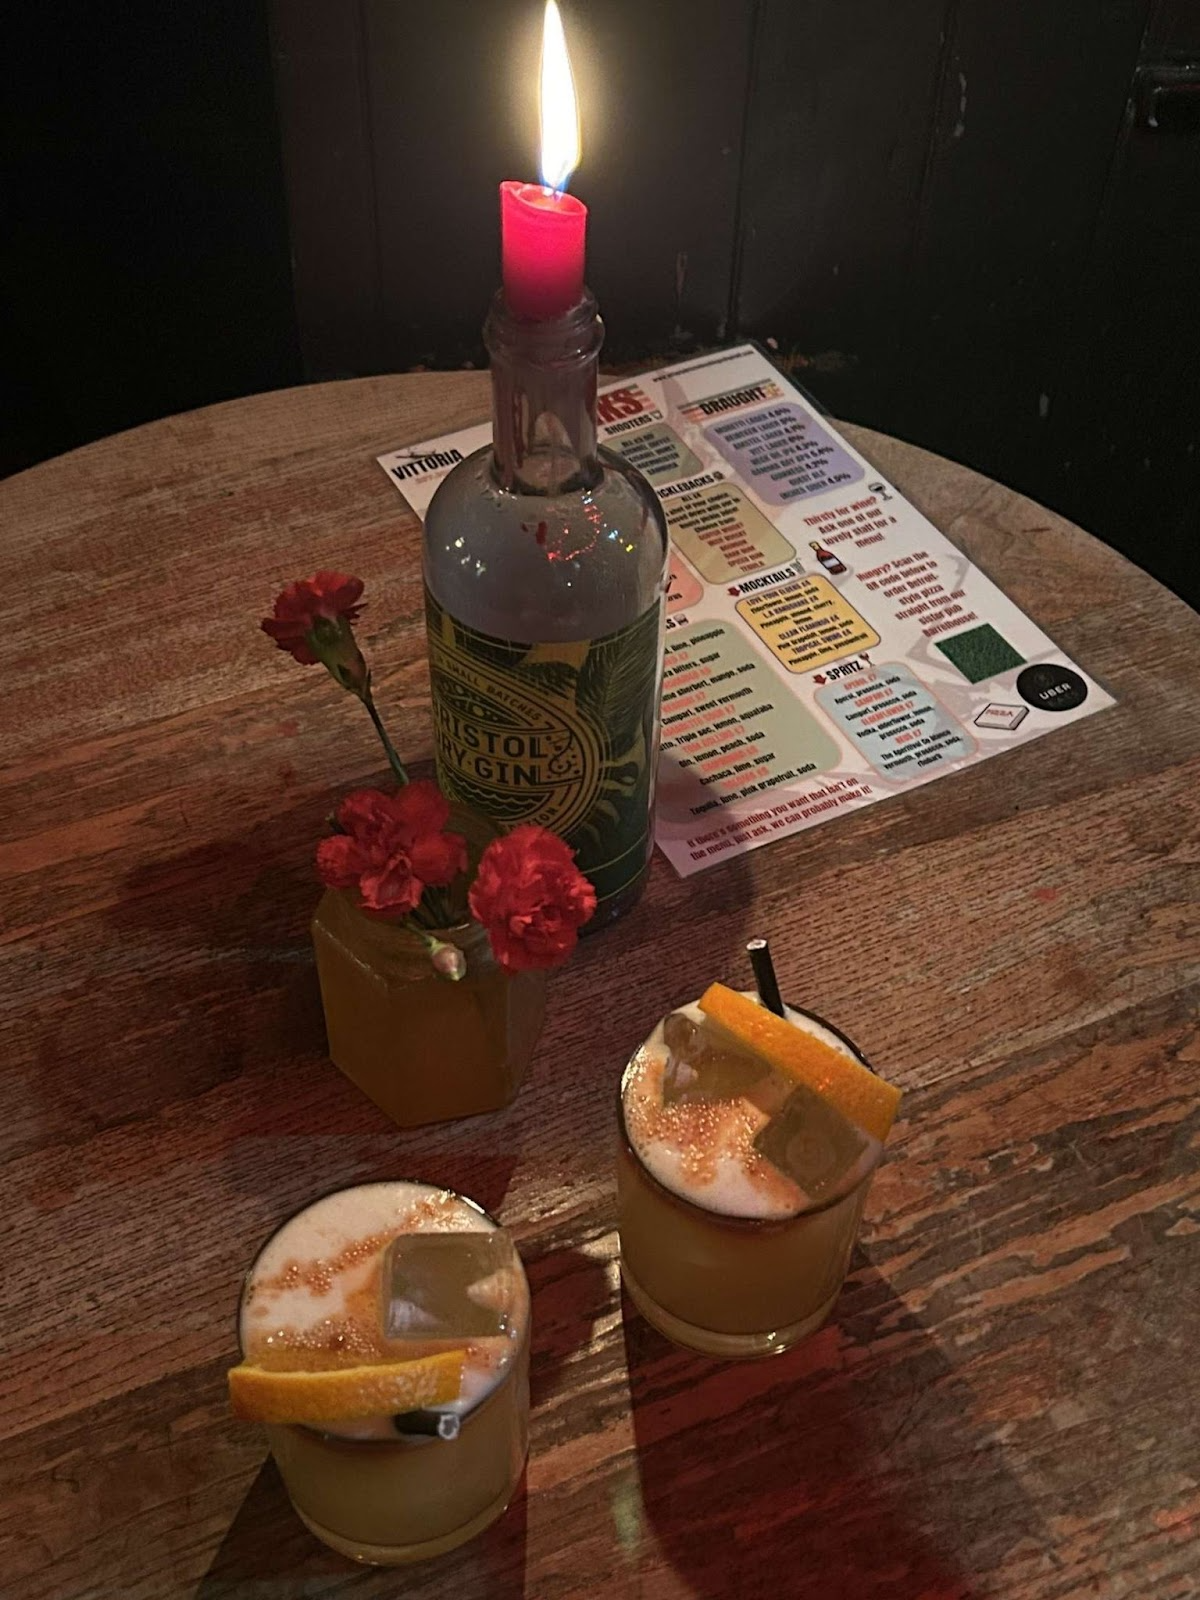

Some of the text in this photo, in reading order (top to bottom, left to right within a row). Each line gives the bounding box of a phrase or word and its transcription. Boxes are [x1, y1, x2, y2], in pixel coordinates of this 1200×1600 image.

[700, 387, 766, 414] DRAUGHT
[605, 414, 651, 434] SHOOTERS
[393, 449, 464, 479] VITTORIA
[657, 475, 713, 497] ICKLEBACKS
[804, 496, 877, 525] Thirsty for wine?
[819, 508, 882, 533] Ask one of our
[823, 531, 852, 545] lovely
[853, 523, 874, 535] staff
[874, 519, 888, 528] for
[855, 532, 884, 547] menu!
[857, 551, 928, 580] Hungry? Scan the
[879, 574, 901, 586] code
[900, 564, 926, 577] below
[926, 560, 937, 568] to
[739, 568, 795, 592] MOCKTAILS
[884, 584, 907, 597] order
[896, 589, 965, 619] straight from our
[899, 584, 943, 605] style pizza
[919, 604, 962, 624] sister pub
[690, 628, 724, 645] pineapple
[700, 652, 720, 663] sugar
[737, 663, 755, 672] soda
[827, 660, 863, 679] SPRITZ
[1039, 682, 1072, 700] UBER
[486, 686, 541, 721] BATCHES
[662, 687, 752, 724] Campari, sweet vermouth
[675, 732, 697, 744] Triple
[694, 749, 721, 761] lemon,
[720, 739, 746, 753] peach,
[746, 731, 765, 742] soda
[754, 752, 775, 764] sugar
[740, 785, 758, 796] pink
[758, 770, 797, 789] grapefruit,
[797, 763, 816, 774] soda
[687, 777, 858, 847] If there's something you want that isn't on
[690, 784, 872, 860] the menu, just ask, we can probably make it!
